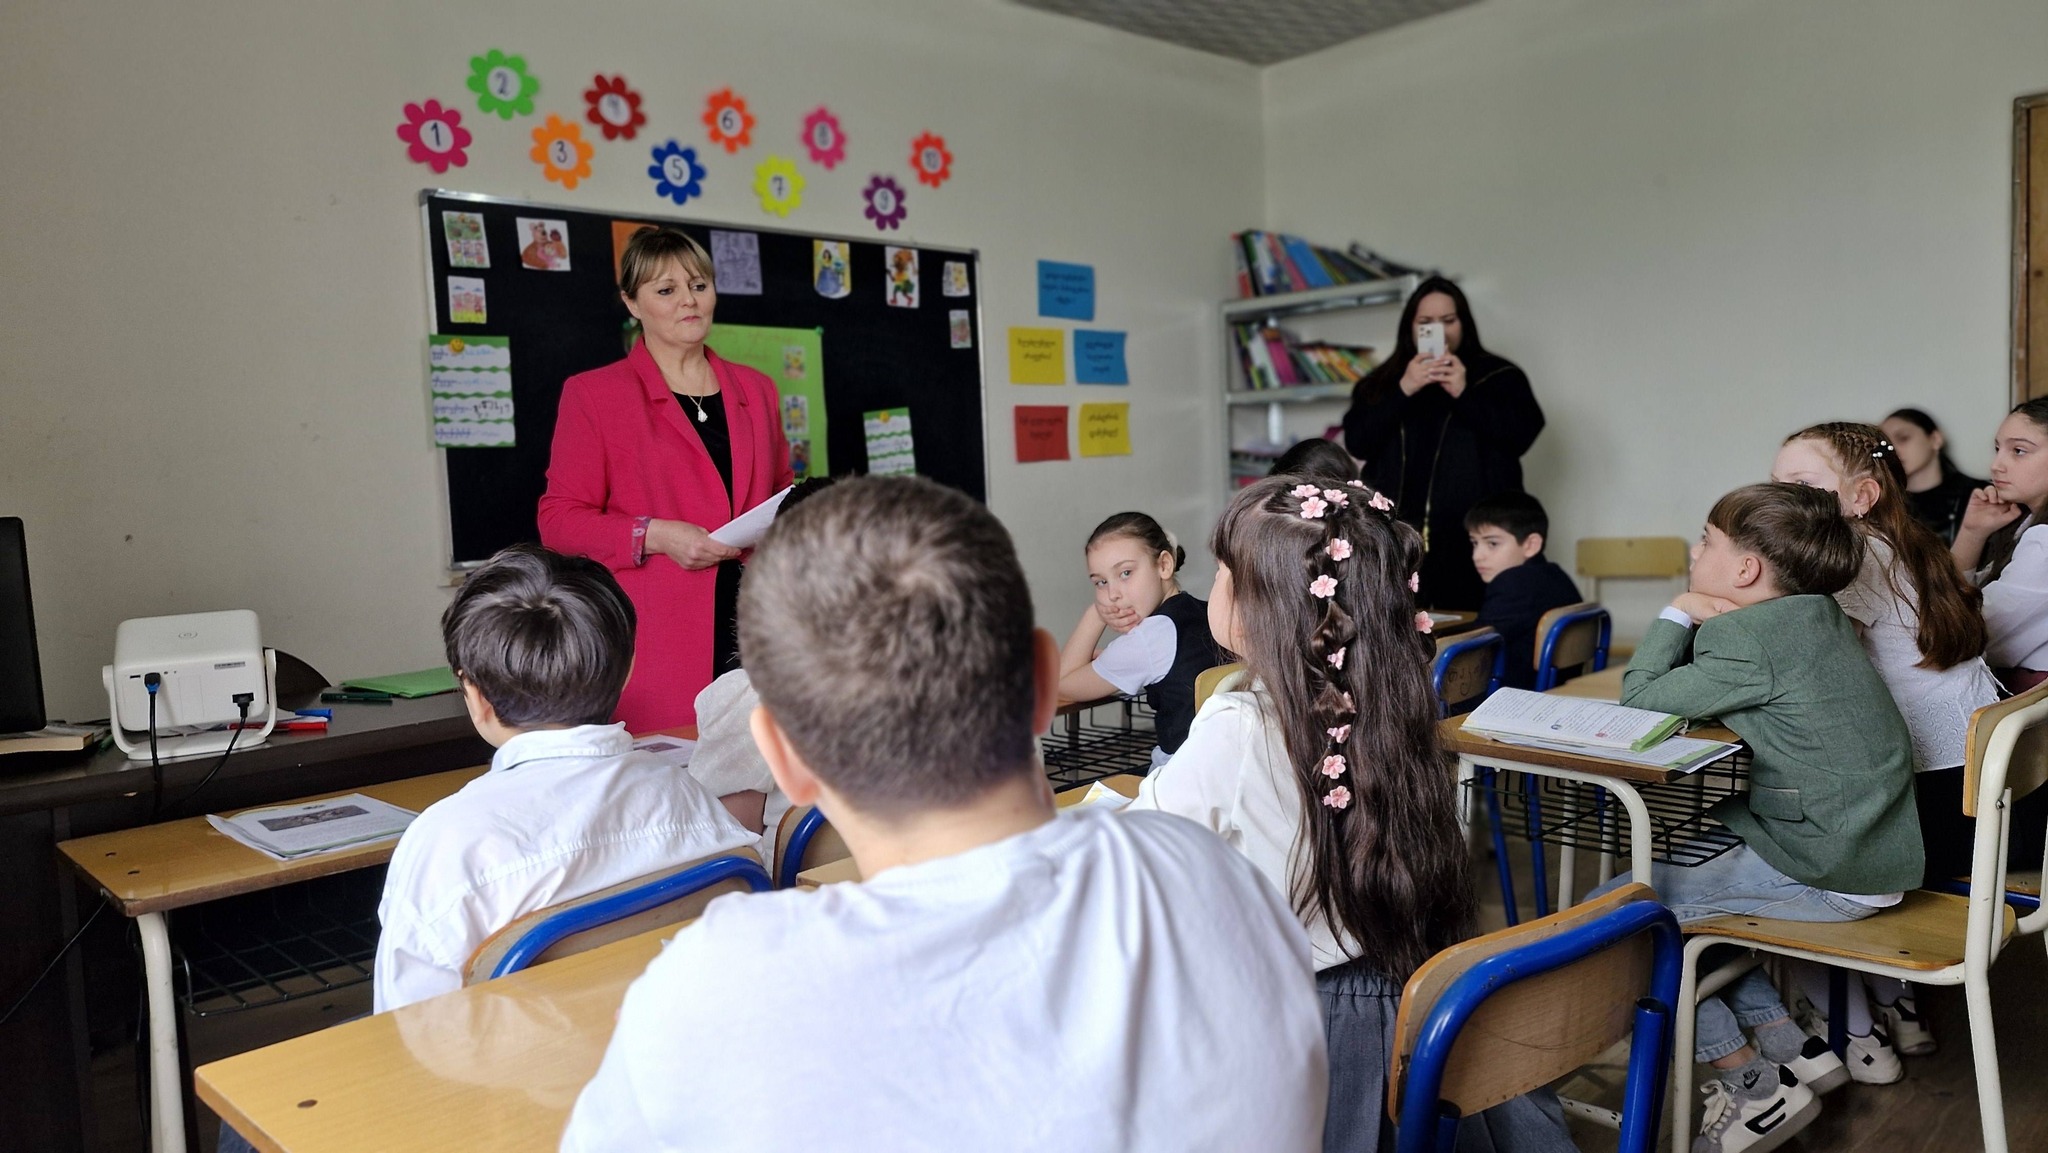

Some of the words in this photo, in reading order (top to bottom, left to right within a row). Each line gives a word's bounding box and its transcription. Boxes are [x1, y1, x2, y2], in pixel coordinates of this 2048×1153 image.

[496, 72, 508, 96] 2
[723, 110, 734, 130] 6
[431, 122, 441, 147] 1
[556, 141, 568, 164] 3
[671, 158, 684, 181] 5
[772, 176, 783, 196] 7
[880, 191, 889, 211] 9
